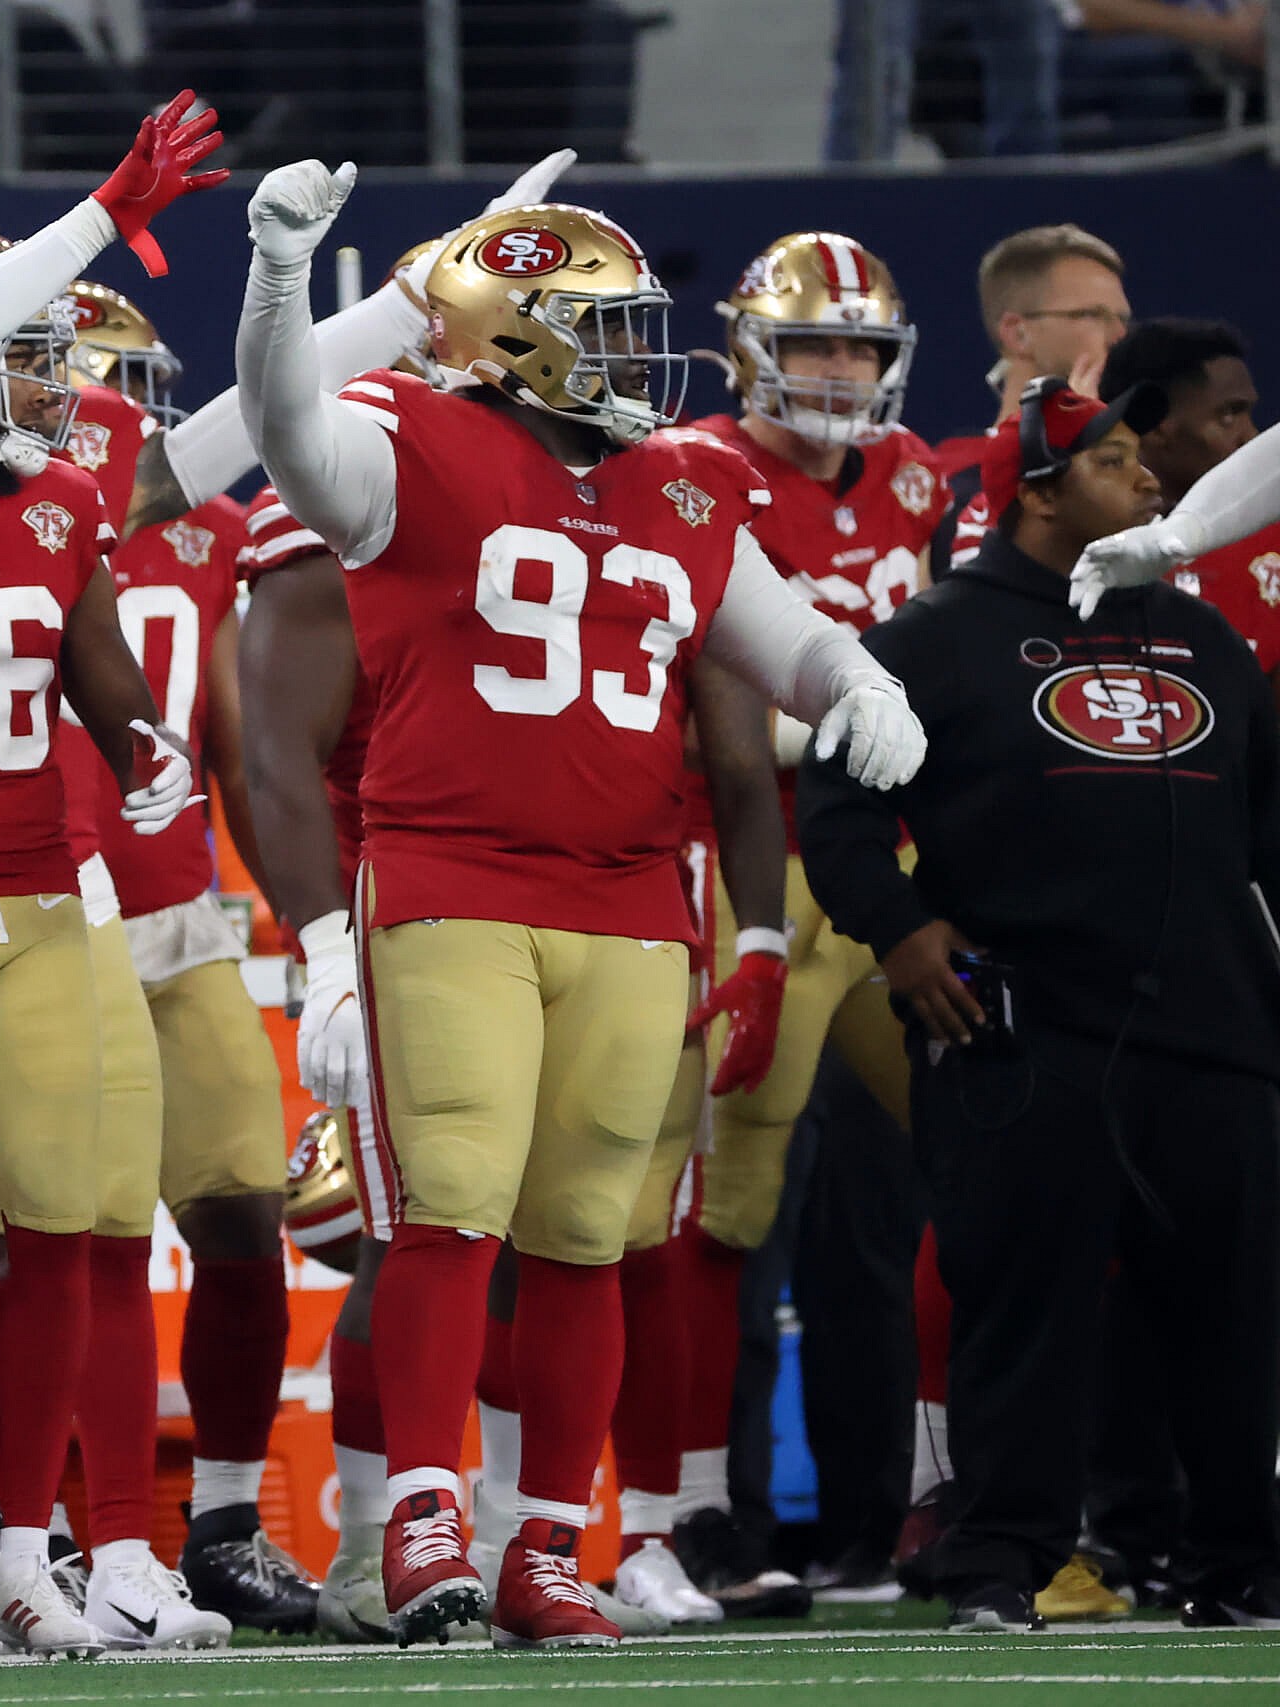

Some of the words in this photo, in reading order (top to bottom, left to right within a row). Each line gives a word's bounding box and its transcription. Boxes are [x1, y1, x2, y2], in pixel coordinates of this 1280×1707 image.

[497, 233, 553, 271] SF
[677, 487, 703, 513] 75
[36, 512, 64, 536] 75
[557, 516, 620, 536] 49ERS
[474, 524, 695, 732] 93
[1082, 679, 1182, 744] SF
